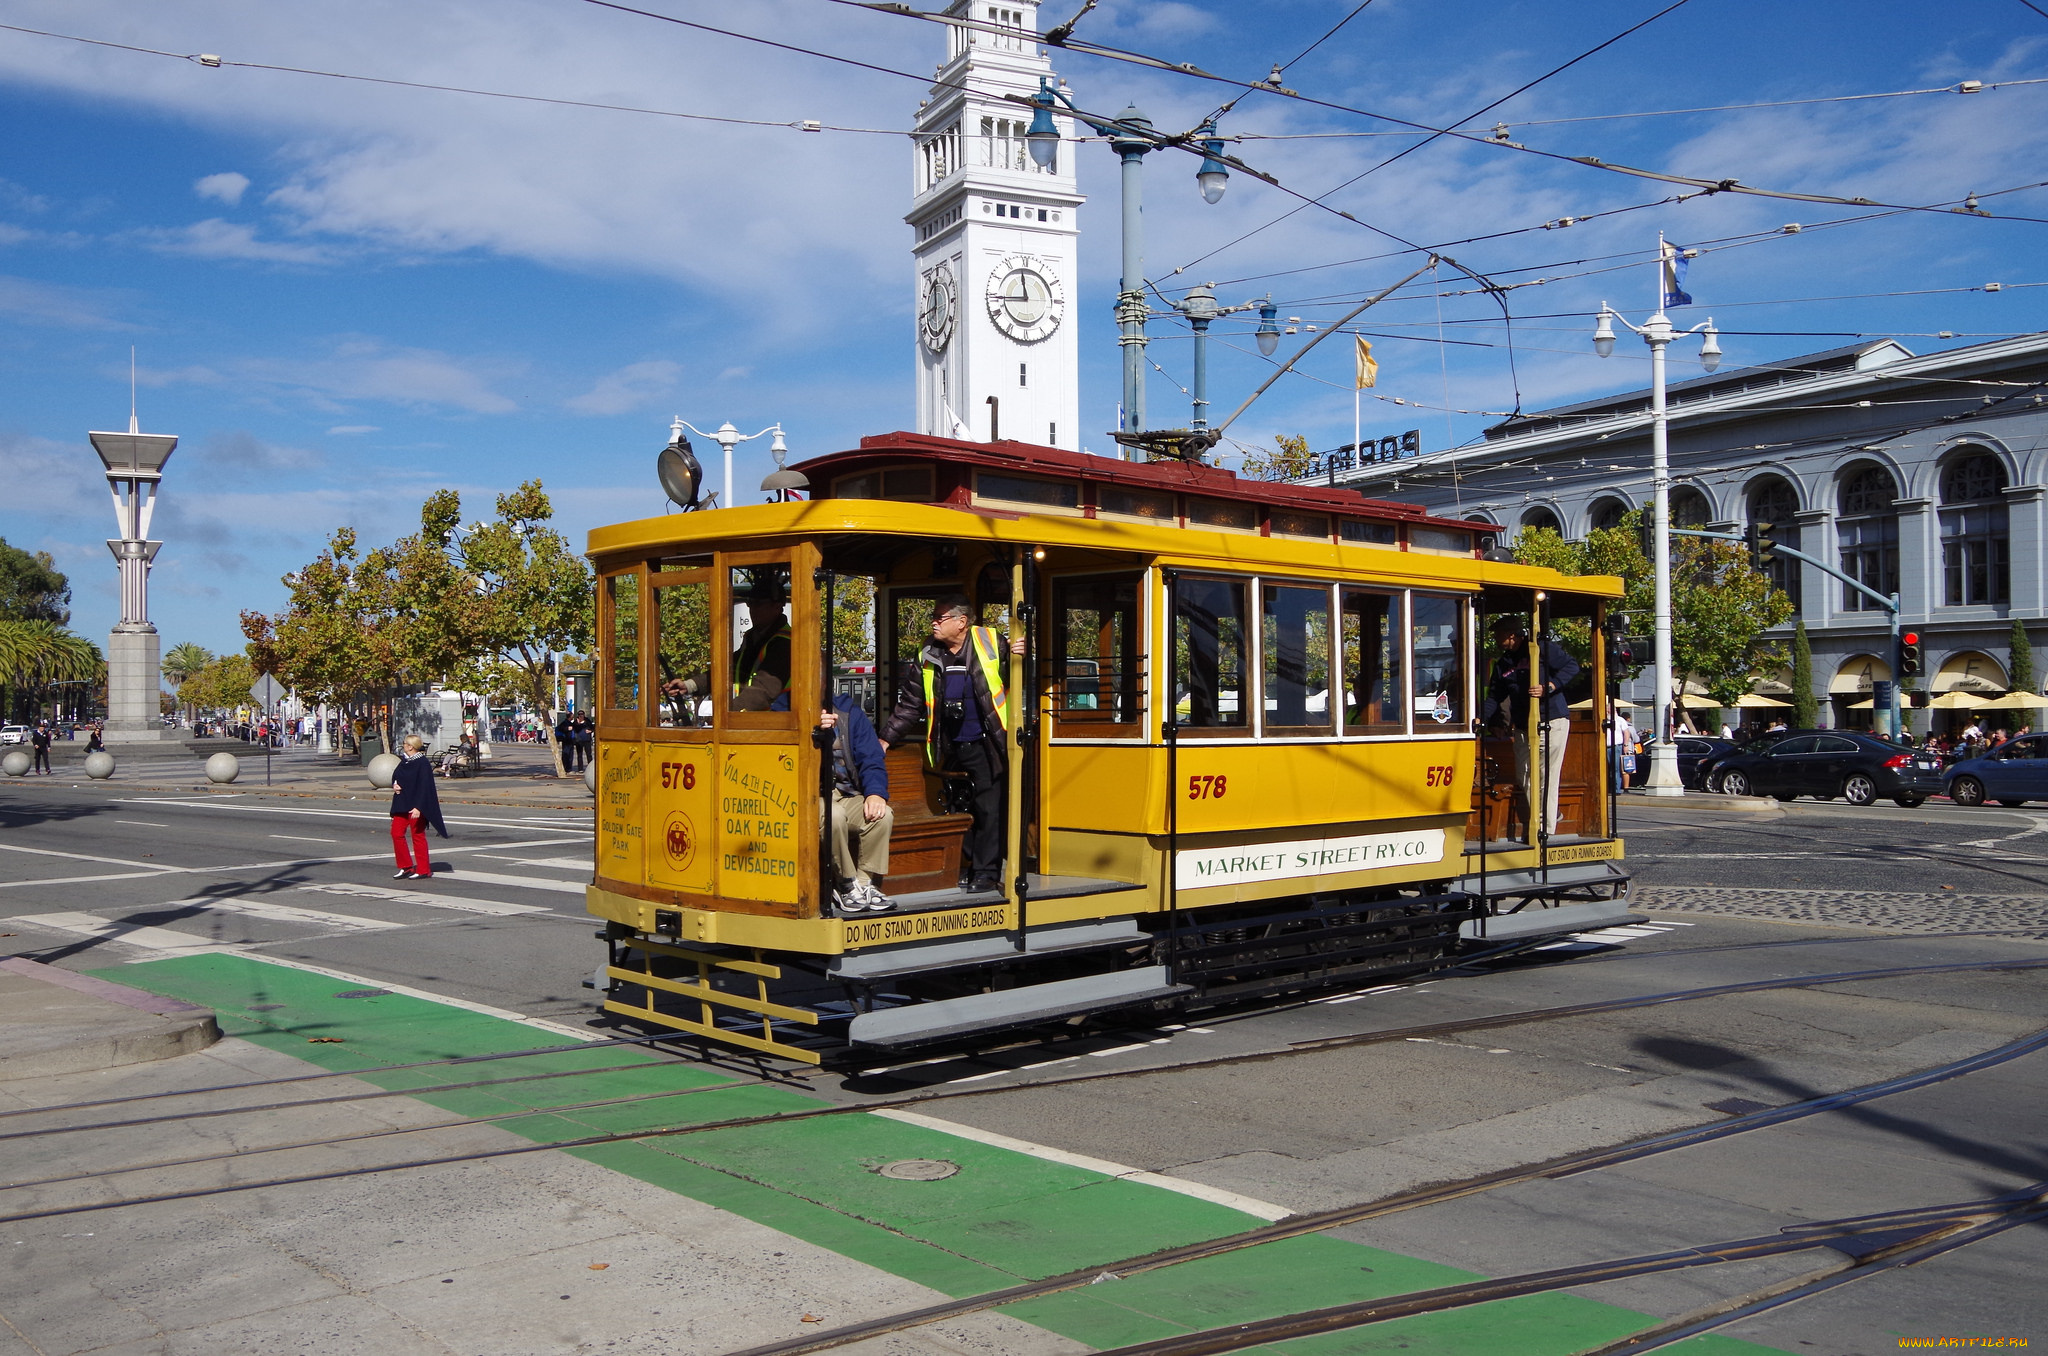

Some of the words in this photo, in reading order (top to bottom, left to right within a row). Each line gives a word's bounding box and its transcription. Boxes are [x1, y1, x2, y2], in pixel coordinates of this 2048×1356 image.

[1859, 662, 1873, 682] A
[661, 762, 696, 790] 578
[1426, 766, 1453, 787] 578
[724, 761, 738, 784] VIA
[741, 773, 760, 792] 4TH
[762, 780, 798, 818] ELLIS
[1189, 775, 1227, 800] 578
[611, 791, 631, 806] DEPOT
[723, 797, 770, 816] O'FARRELL
[602, 819, 623, 834] GOLDEN
[626, 824, 642, 838] GATE
[727, 818, 751, 836] OAK
[758, 820, 790, 839] PAGE
[612, 837, 629, 852] PARK
[748, 841, 767, 853] AND
[724, 854, 795, 877] DEVISADERO
[1195, 853, 1287, 877] MARKET
[1295, 845, 1370, 868] STREET
[1375, 842, 1401, 860] RY.
[1403, 840, 1427, 857] CO.
[847, 925, 860, 943] DO
[863, 923, 881, 941] NOT
[884, 918, 913, 938] STAND
[916, 918, 929, 934] ON
[932, 913, 969, 933] RUNNING
[972, 909, 1004, 927] BOARDS
